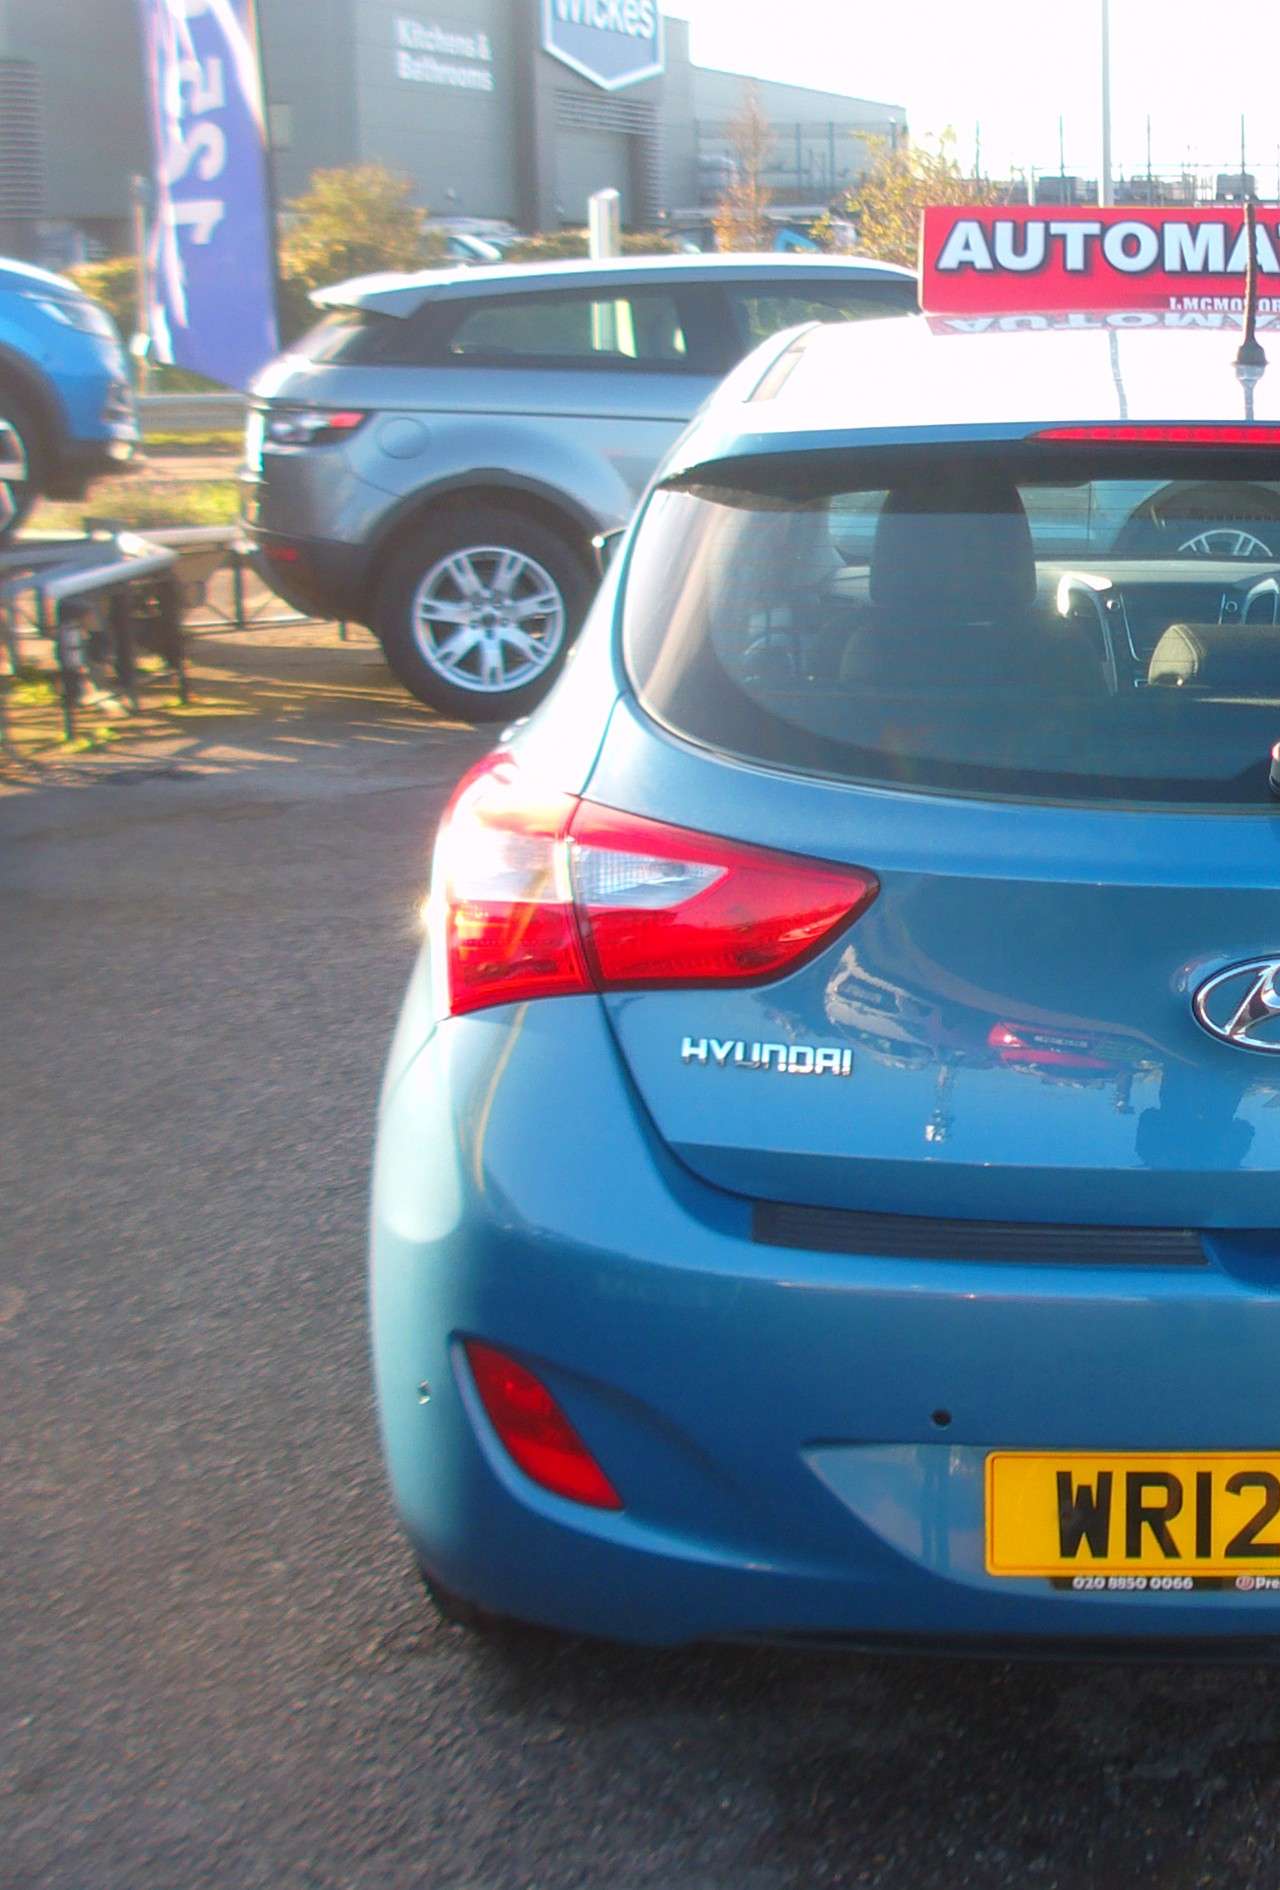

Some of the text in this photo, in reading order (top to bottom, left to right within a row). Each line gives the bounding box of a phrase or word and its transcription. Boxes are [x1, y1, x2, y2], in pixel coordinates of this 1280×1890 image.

[681, 1037, 852, 1077] HYUNDAI
[1072, 1576, 1194, 1590] 020 8850 0066
